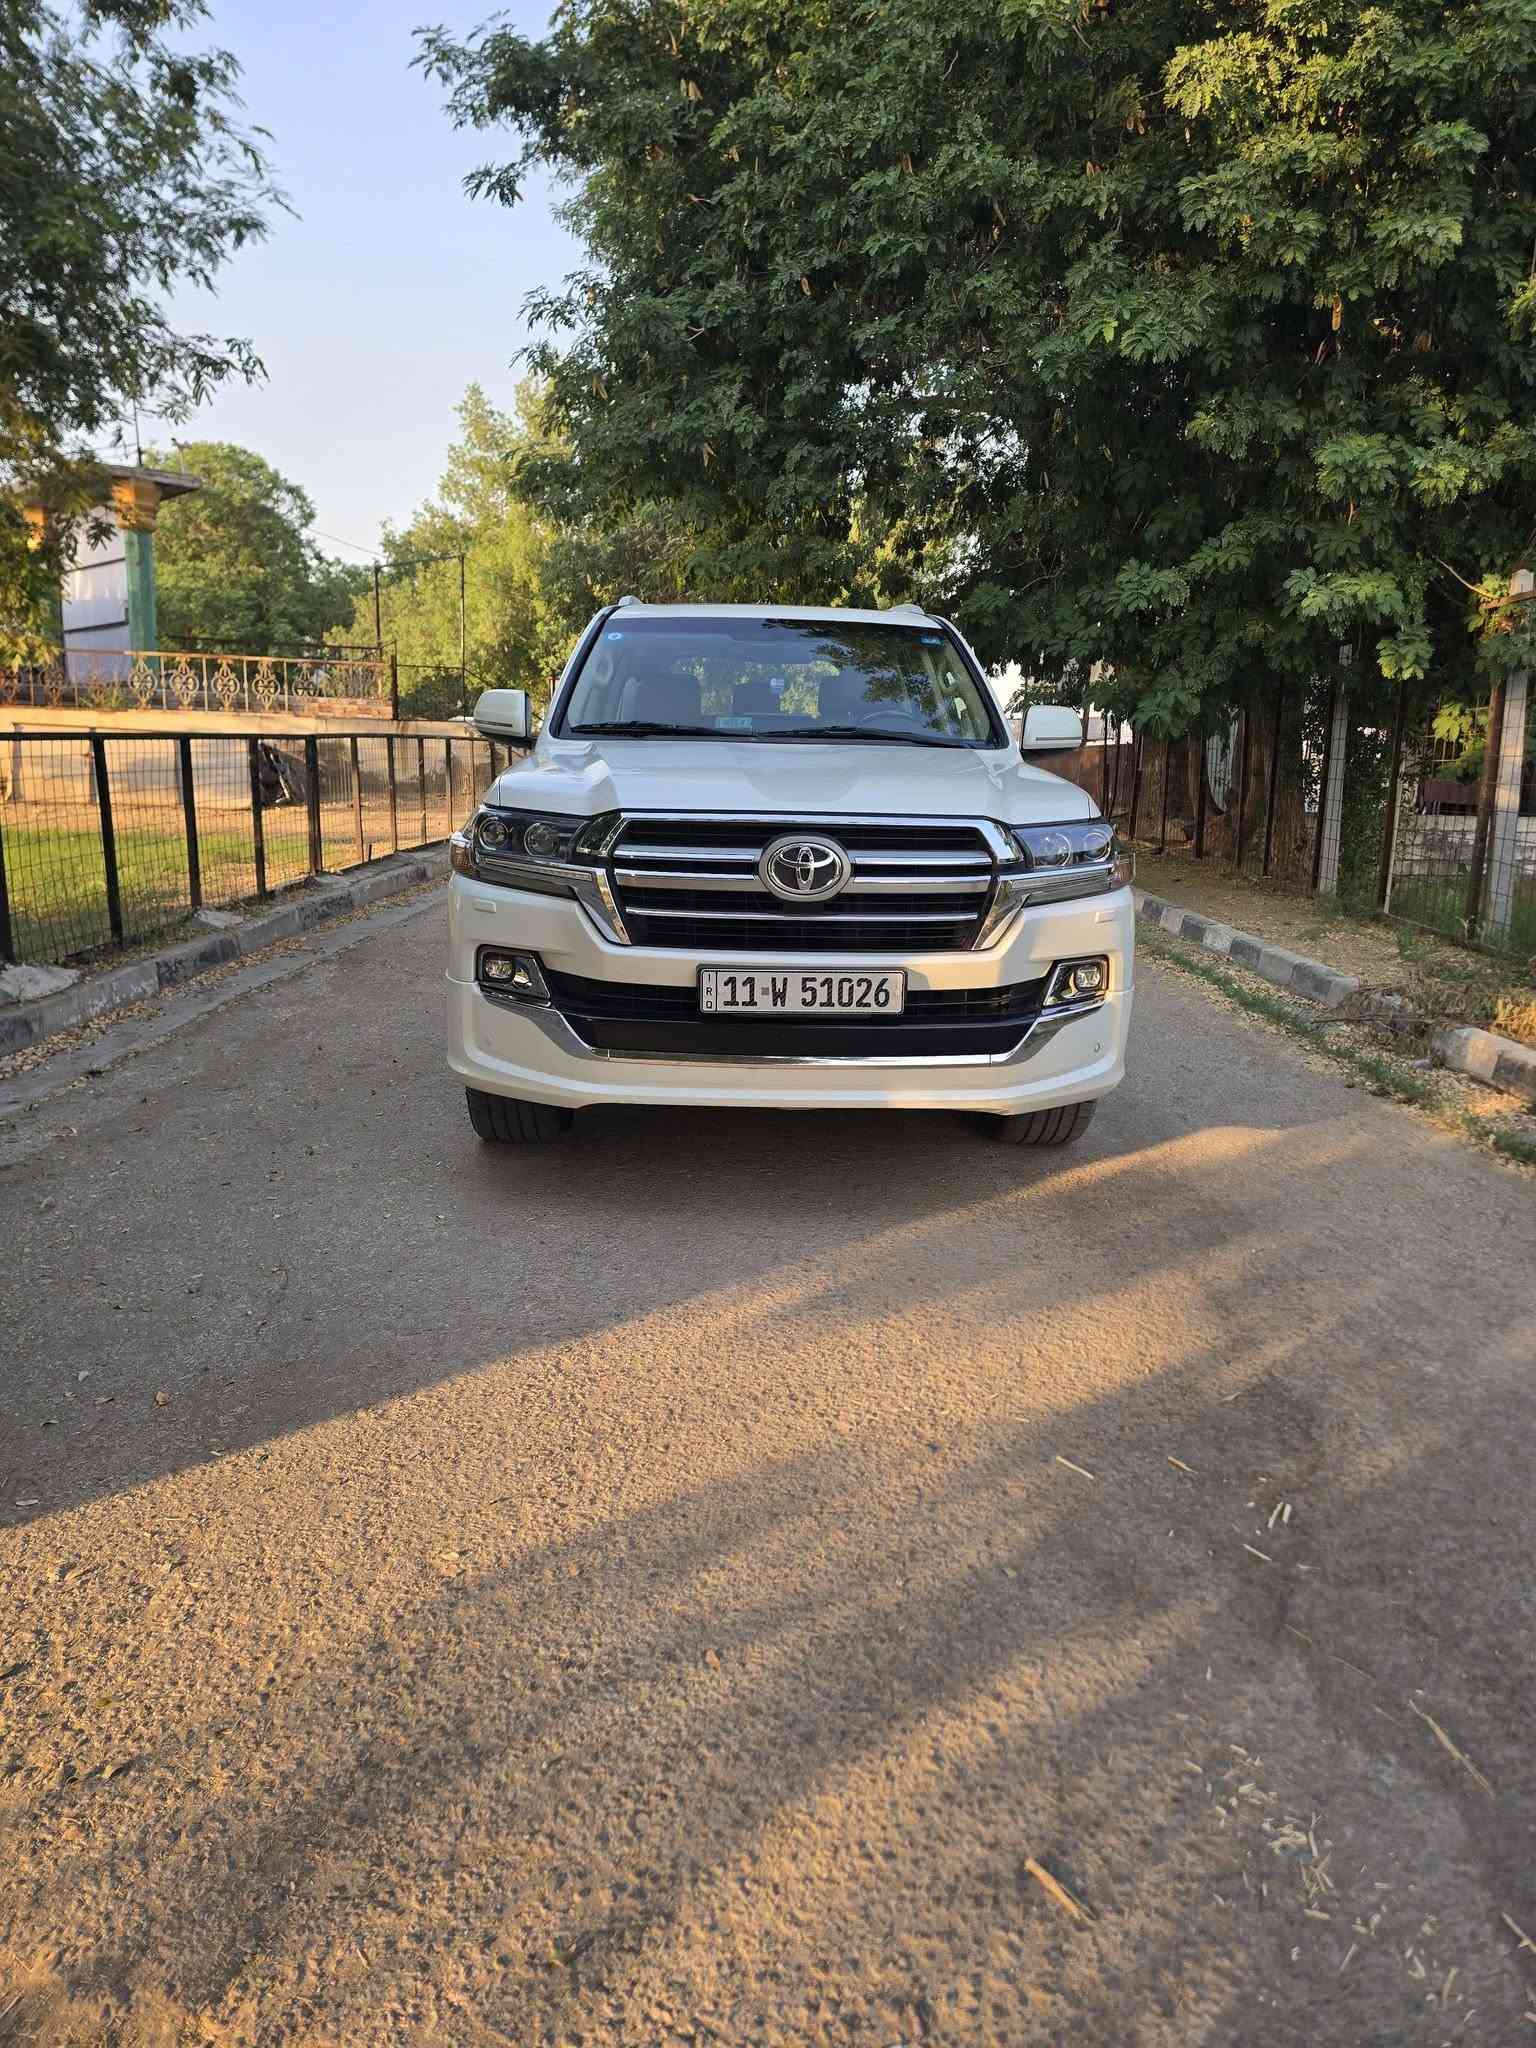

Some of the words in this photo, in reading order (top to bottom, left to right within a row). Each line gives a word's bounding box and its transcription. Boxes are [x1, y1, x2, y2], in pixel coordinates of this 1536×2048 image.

[723, 976, 757, 1007] 11
[771, 976, 788, 1008] W
[801, 976, 890, 1008] 51026
